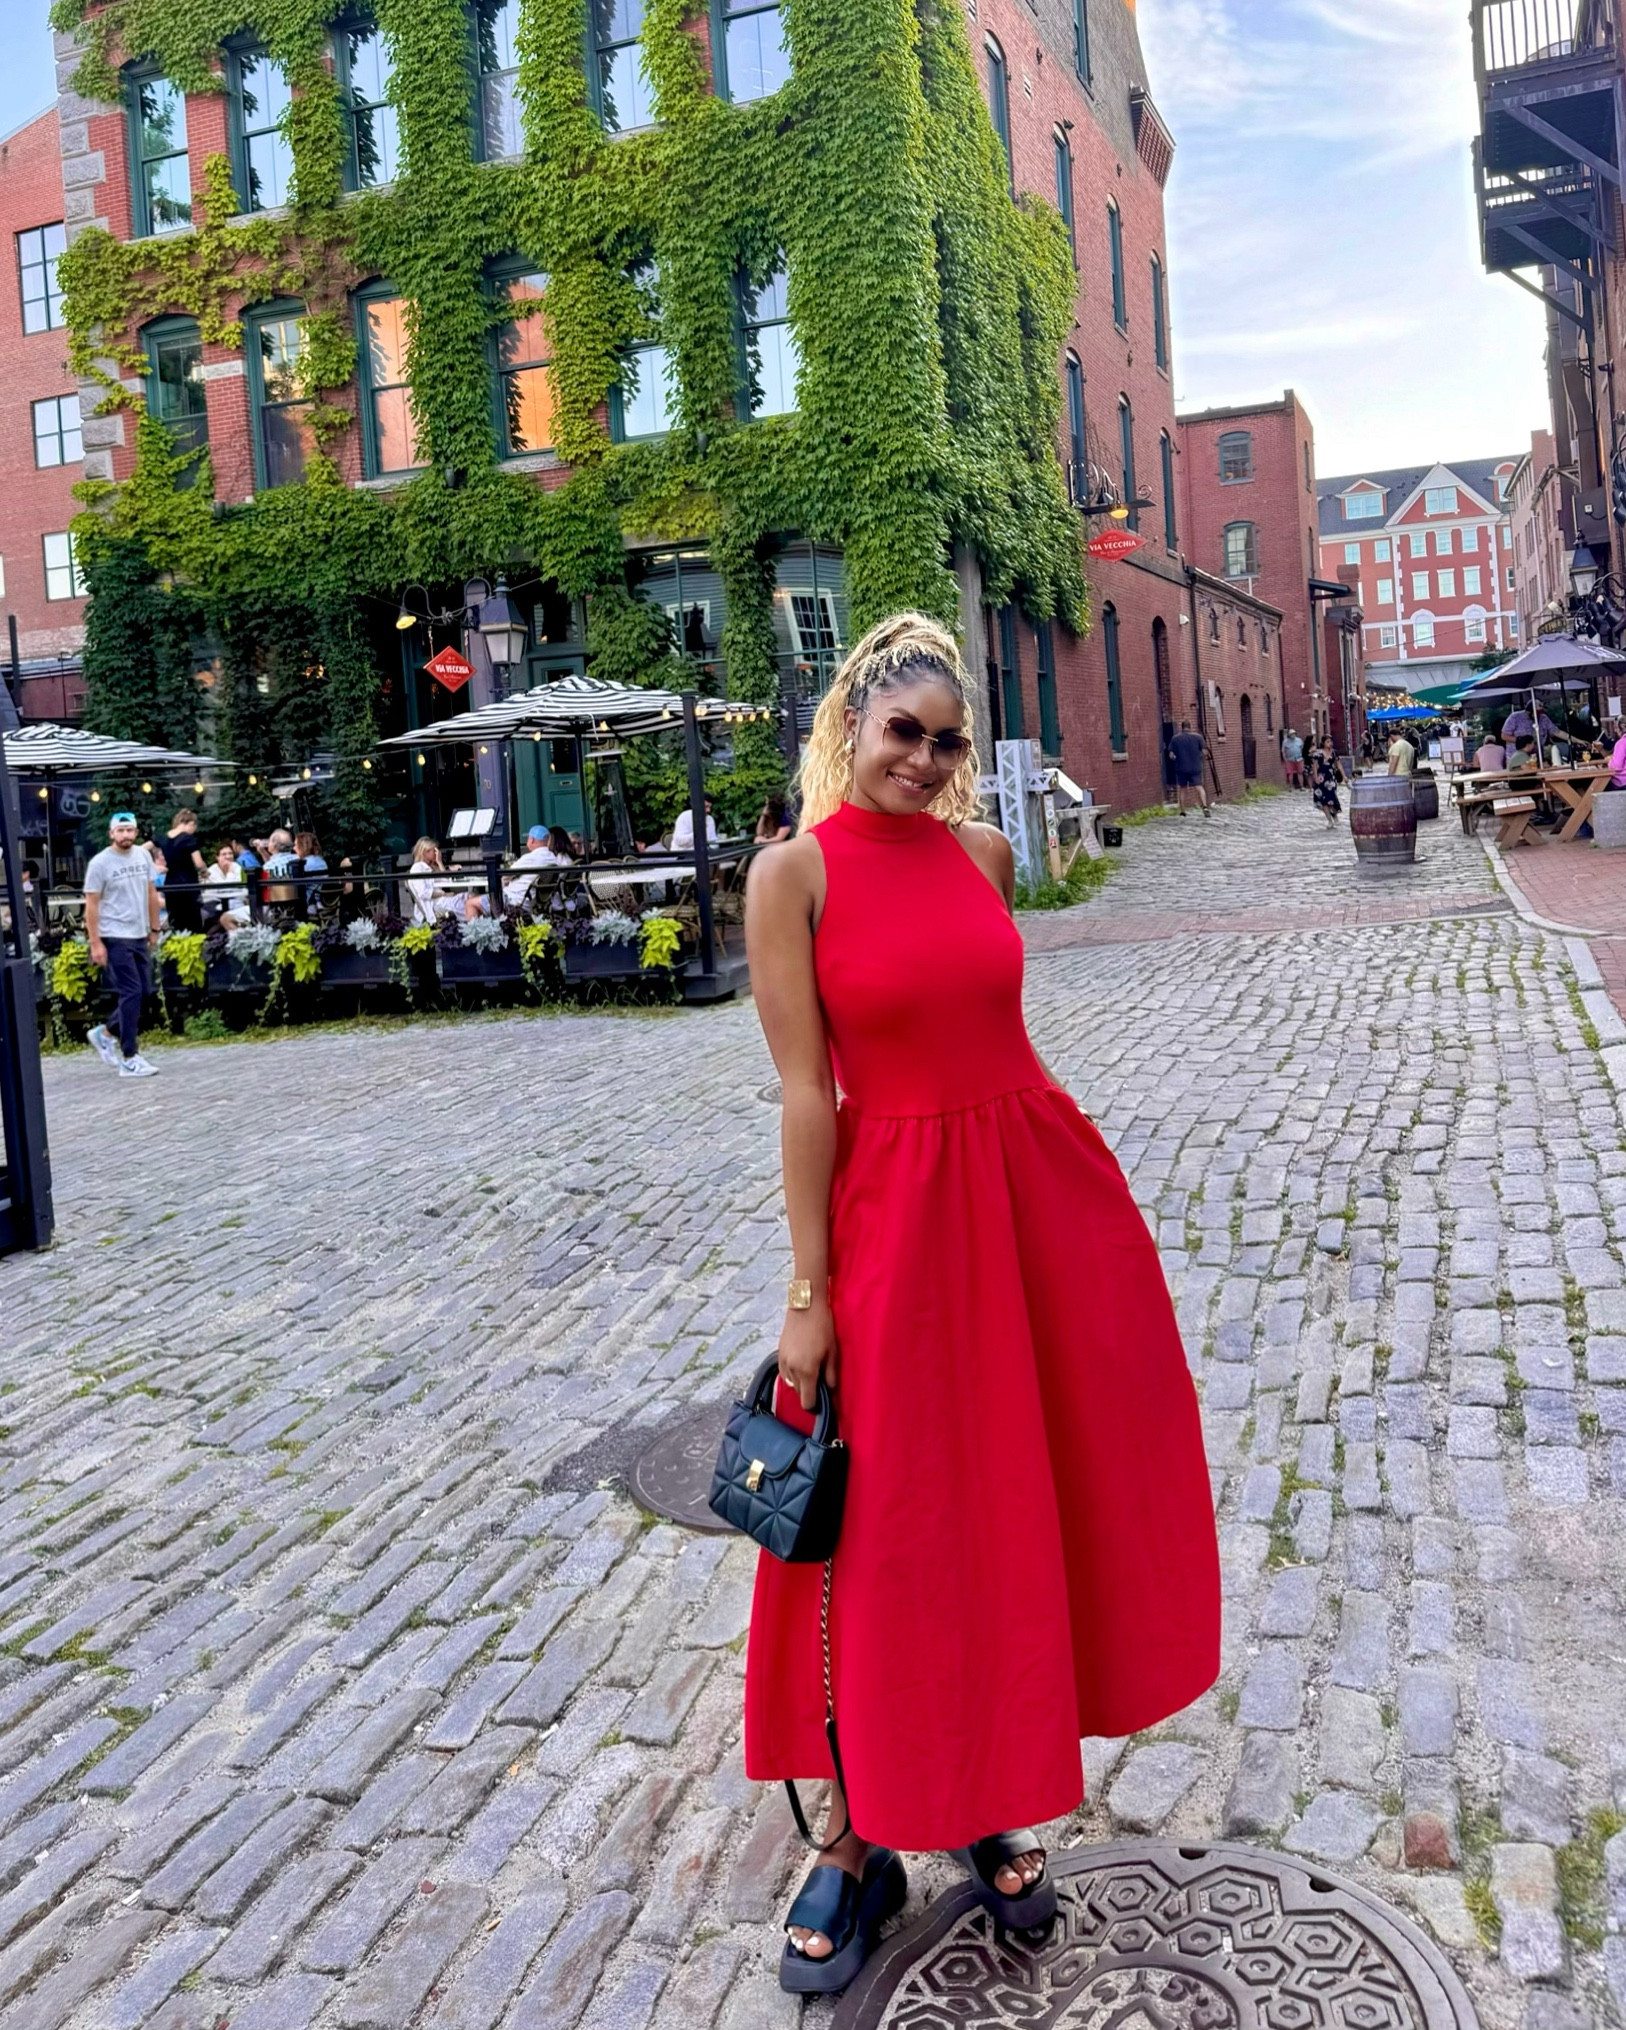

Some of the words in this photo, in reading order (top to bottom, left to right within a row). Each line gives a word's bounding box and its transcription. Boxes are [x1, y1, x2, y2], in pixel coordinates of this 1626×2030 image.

[1089, 543, 1102, 551] VIA
[1103, 539, 1137, 550] VECCHIA
[435, 663, 446, 673] VIA
[446, 664, 470, 675] VECCHIA
